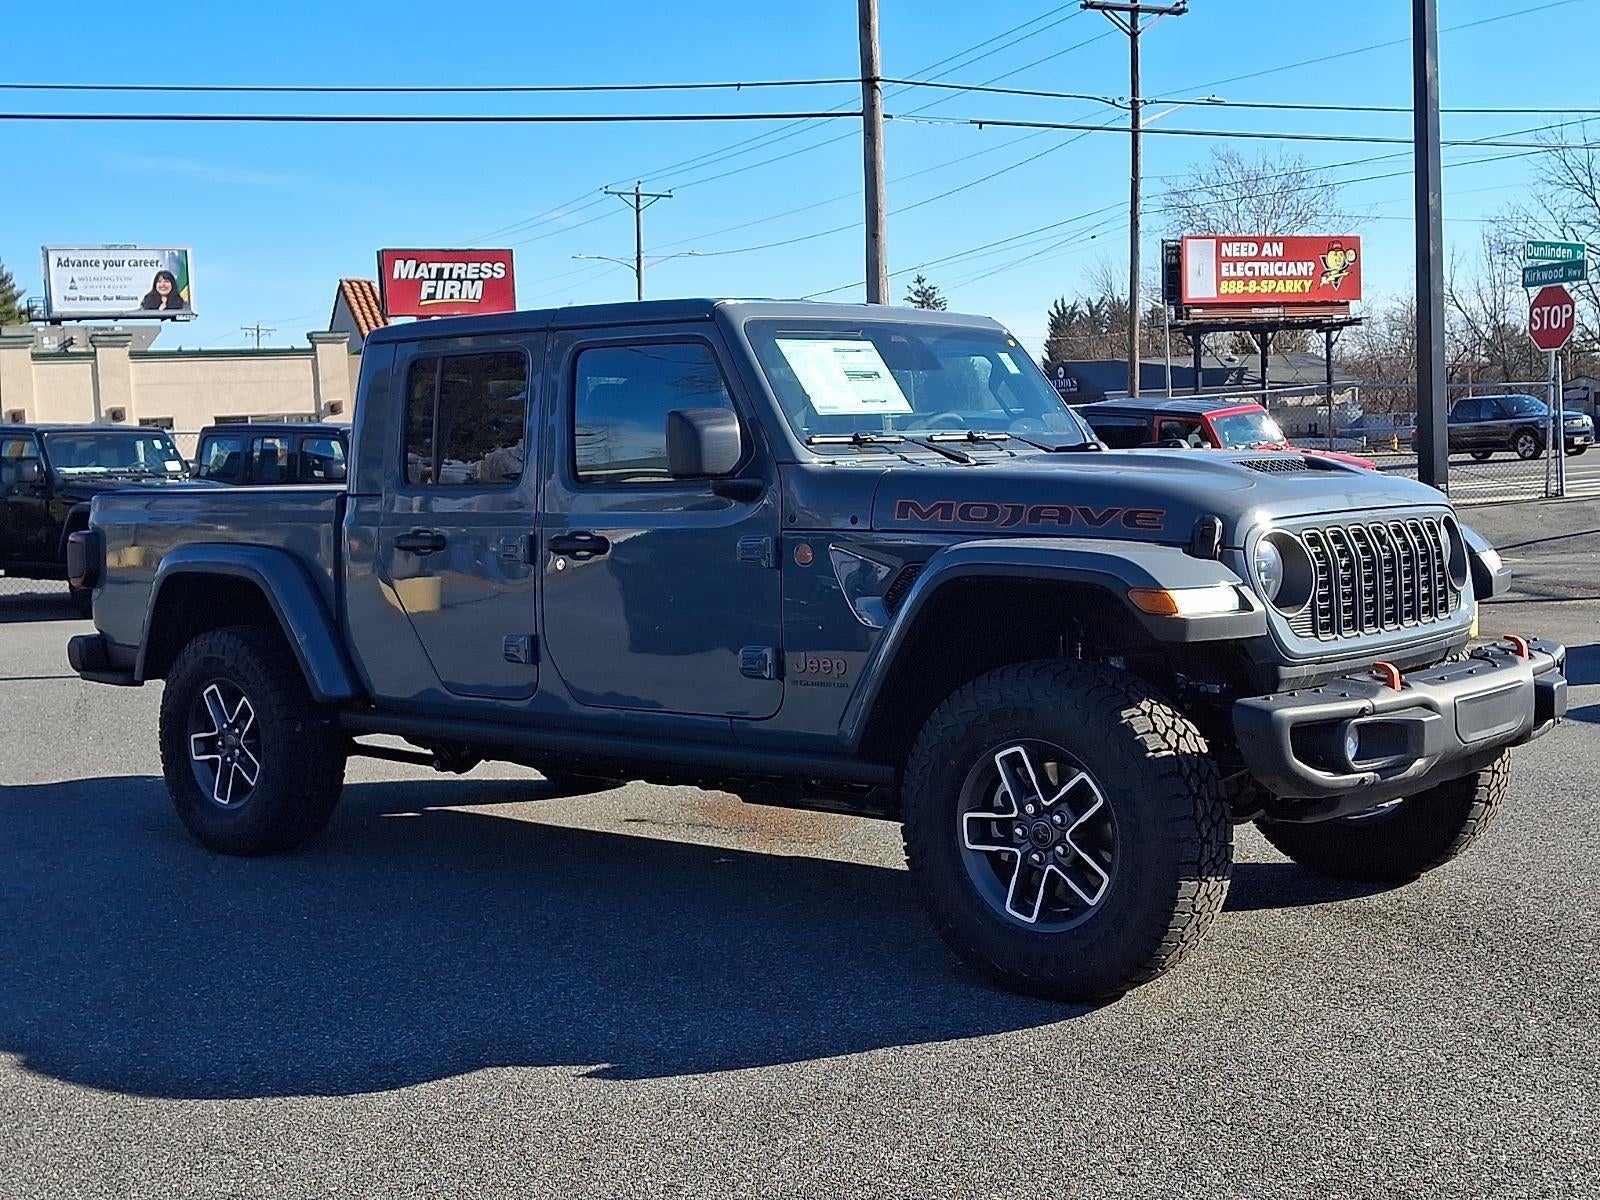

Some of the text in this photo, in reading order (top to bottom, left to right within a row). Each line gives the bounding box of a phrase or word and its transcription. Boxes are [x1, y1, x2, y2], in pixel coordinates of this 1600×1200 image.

[1221, 242, 1284, 257] NEED AN
[1527, 243, 1584, 260] Dunlinden Dr
[56, 257, 163, 271] Advance your career.
[392, 259, 506, 280] MATTRESS
[1221, 261, 1315, 277] ELECTRICIAN?
[1524, 266, 1582, 282] Kirkwood Hwy
[419, 279, 484, 300] FIRM
[1219, 279, 1314, 294] 888-8-SPARKY
[1530, 303, 1573, 331] STOP
[895, 499, 1167, 531] MOJAVE
[793, 651, 847, 679] Jeep
